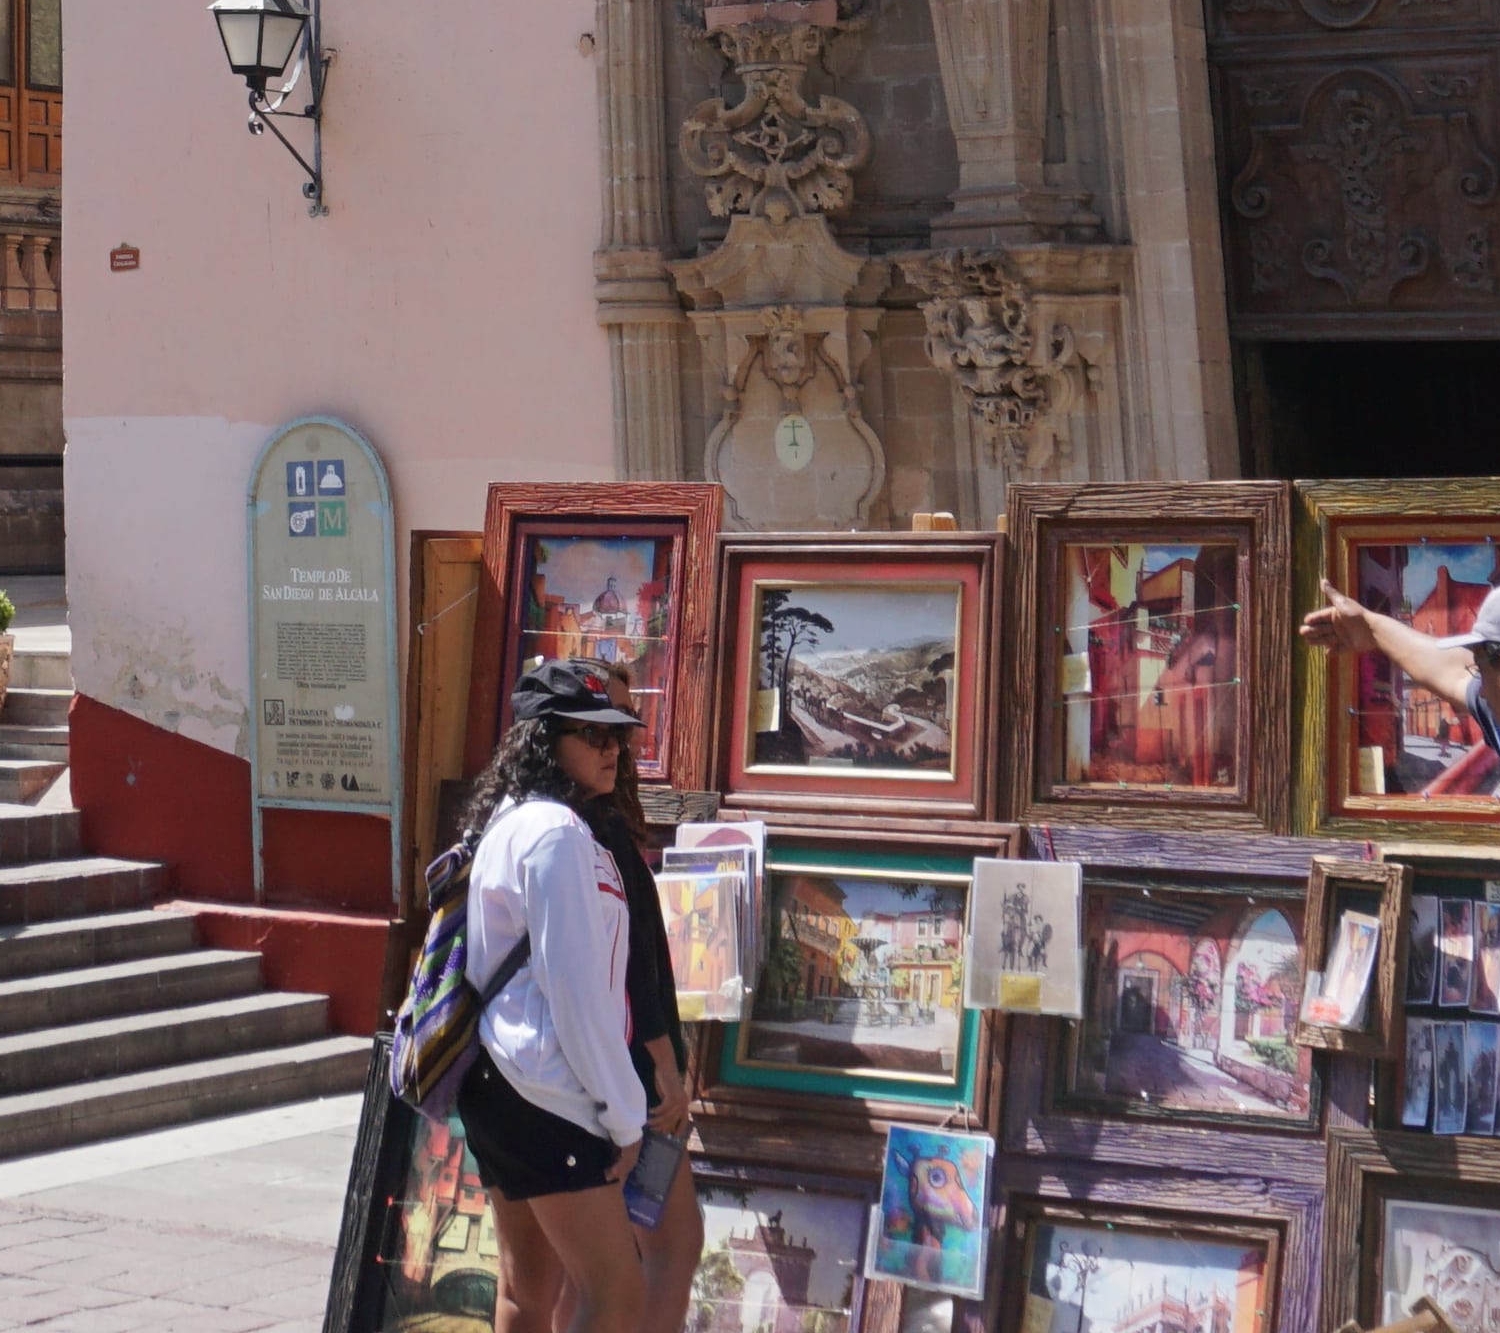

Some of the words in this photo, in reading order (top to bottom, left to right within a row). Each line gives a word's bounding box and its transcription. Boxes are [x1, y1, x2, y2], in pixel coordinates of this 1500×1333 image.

[323, 507, 342, 531] M
[289, 567, 335, 583] TEMPLO
[336, 568, 352, 583] DE
[263, 584, 283, 600] SAN
[284, 585, 314, 601] DIEGO
[319, 588, 334, 601] DE
[335, 587, 379, 603] ALCALA
